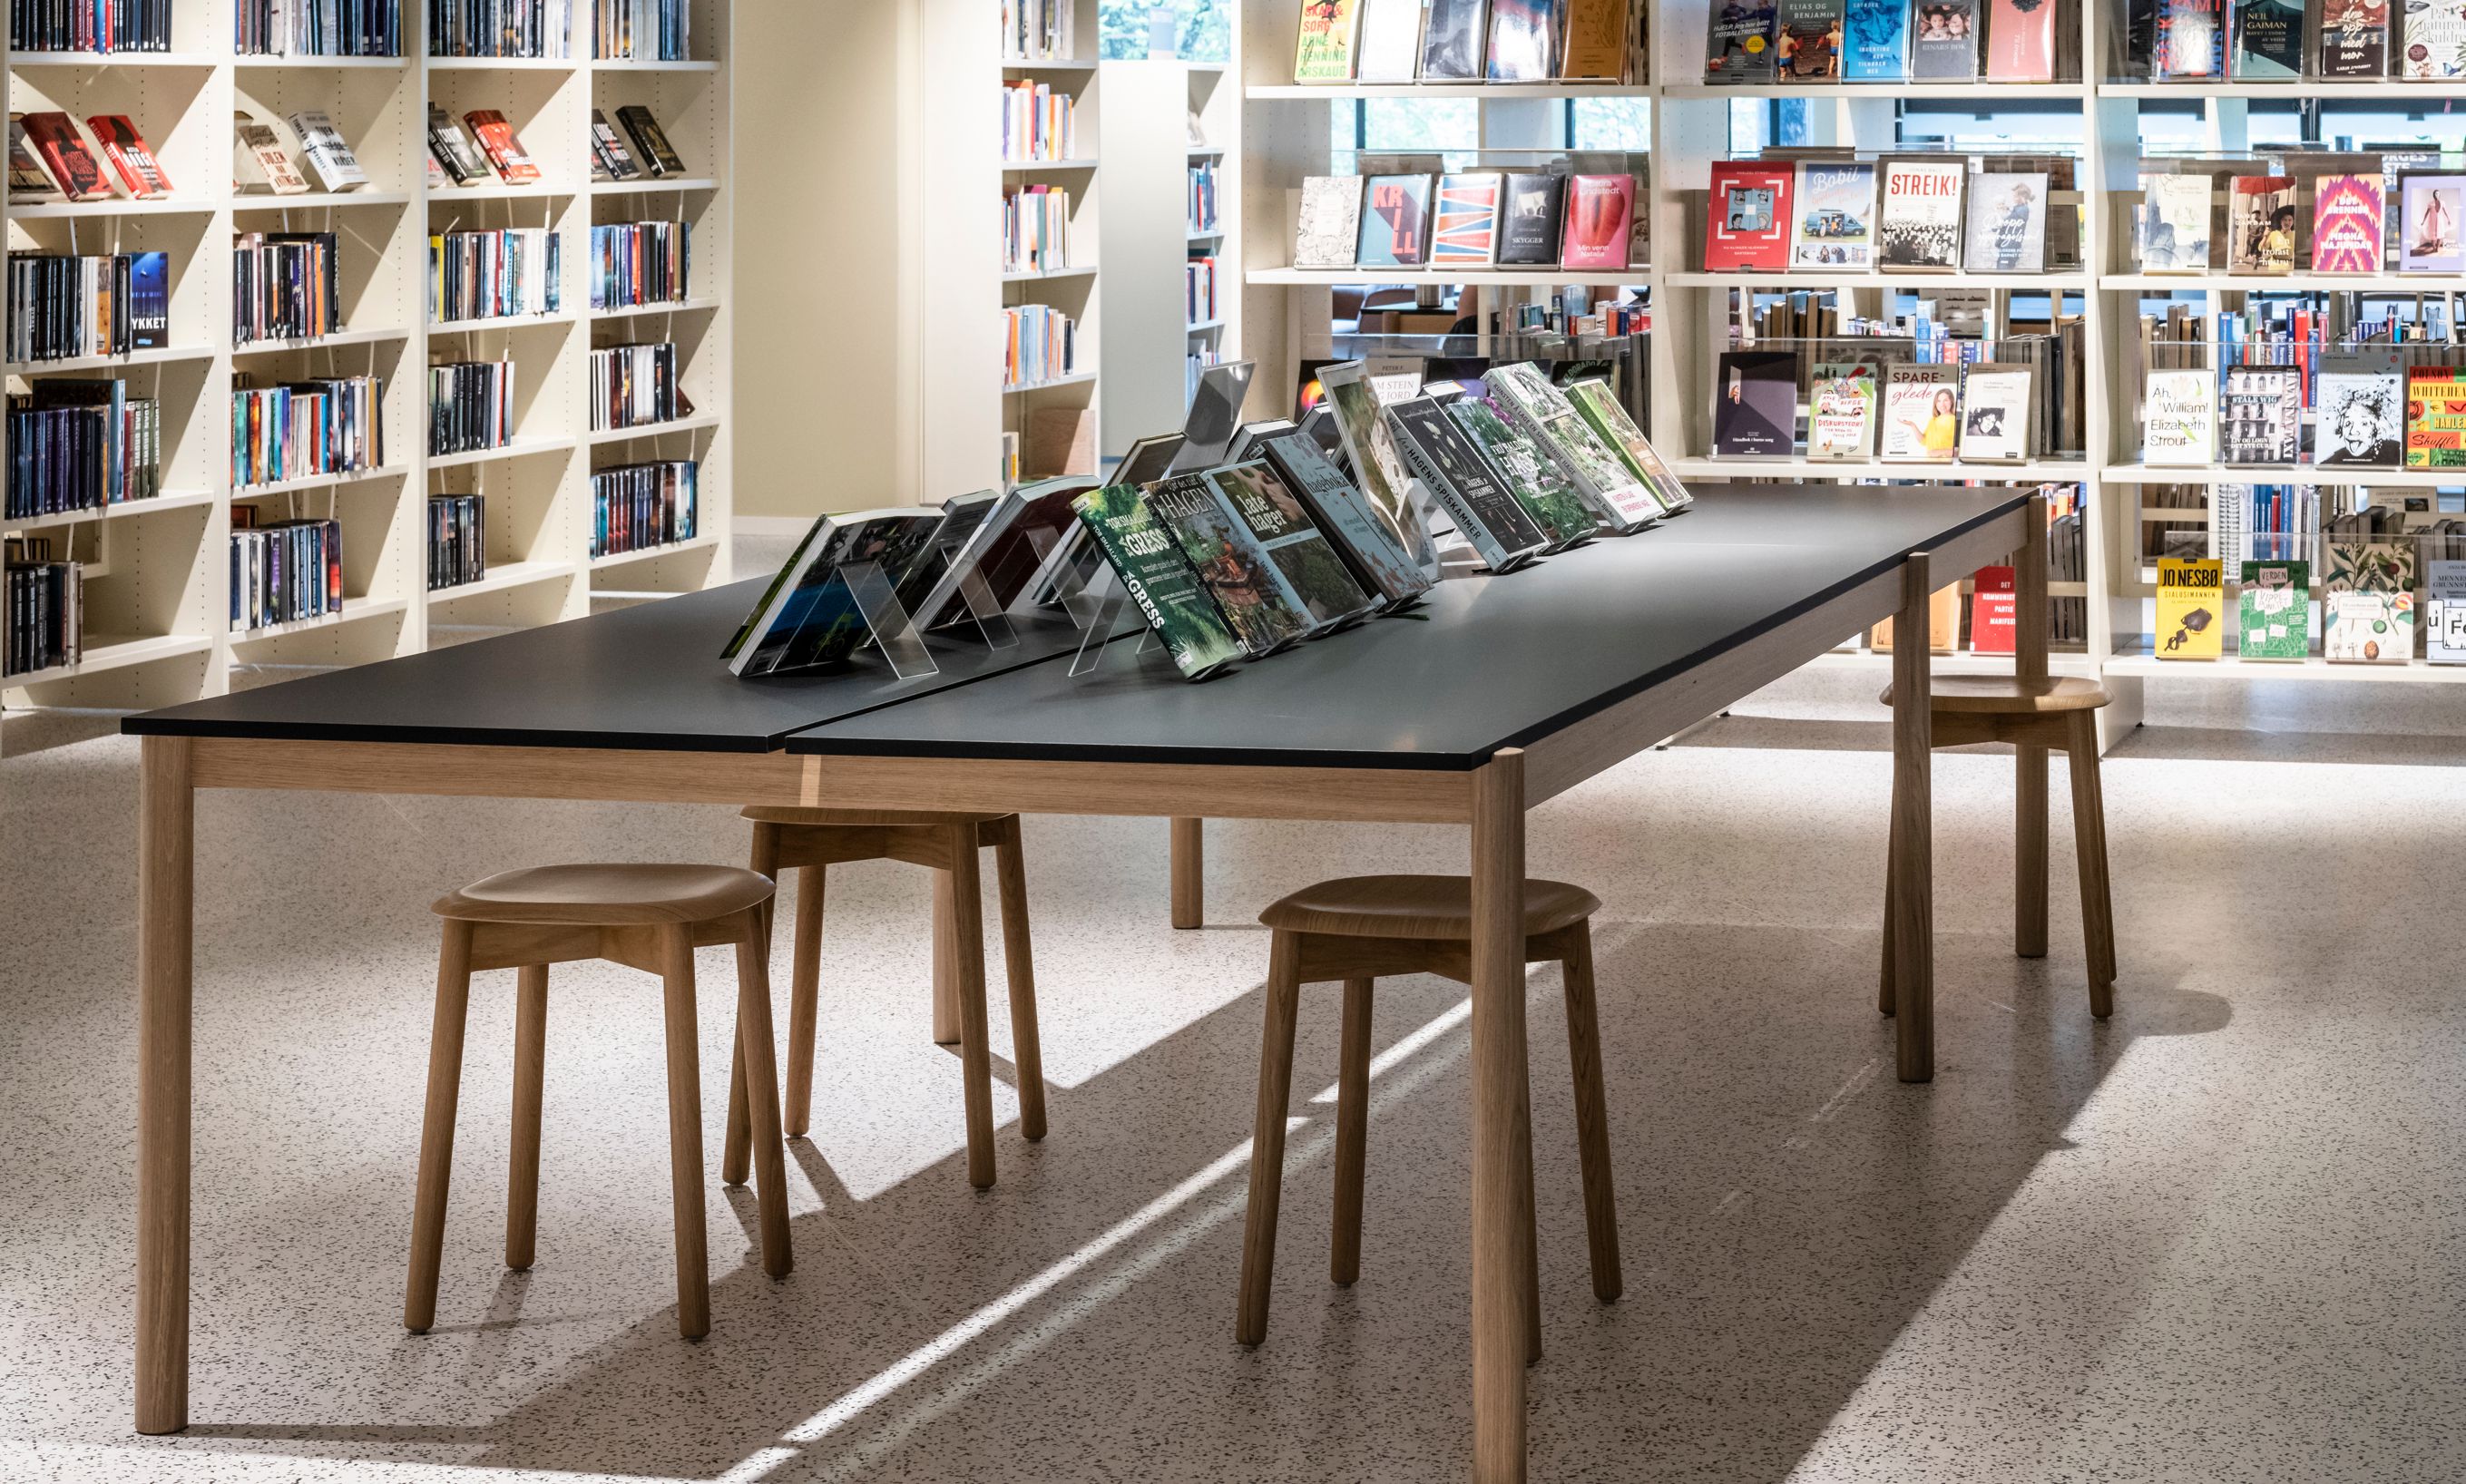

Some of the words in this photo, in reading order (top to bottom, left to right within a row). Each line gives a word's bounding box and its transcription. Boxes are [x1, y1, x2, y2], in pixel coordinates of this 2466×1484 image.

[2246, 21, 2287, 29] GAIMAN
[2342, 24, 2363, 36] opp
[2340, 34, 2365, 48] med
[2340, 52, 2365, 61] mor
[1813, 166, 1860, 194] Bobil
[1891, 173, 1957, 196] STREIK!
[1512, 236, 1543, 244] SKYGGER
[1893, 372, 1945, 384] SPARE-
[2412, 368, 2451, 379] COLSON
[1386, 380, 1414, 390] STEIN
[1386, 390, 1411, 400] JORD
[1891, 383, 1933, 406] glede
[2259, 395, 2277, 404] WIG
[2163, 402, 2208, 414] William!
[1492, 381, 1515, 408] KUNSTEN
[1516, 408, 1531, 425] LAGE
[1527, 422, 1539, 433] EN
[1534, 429, 1564, 463] SPENNENDE
[1560, 458, 1577, 476] HAGE
[2150, 419, 2206, 431] Elizabeth
[2149, 434, 2187, 447] Strout
[2283, 423, 2295, 459] TAXI
[1499, 448, 1541, 476] HAGE
[1301, 472, 1349, 495] hageboka
[1405, 447, 1437, 485] HAGENS
[1433, 482, 1483, 541] SPISKAMMER
[1591, 493, 1603, 505] Lars
[1160, 486, 1217, 519] HAGEN
[1236, 493, 1269, 516] late
[1244, 509, 1287, 533] hager
[1091, 523, 1103, 538] TOR
[1098, 534, 1123, 568] SMAALAND
[1125, 528, 1169, 556] GRESS
[1258, 559, 1271, 574] late
[1267, 571, 1284, 592] hager
[2162, 569, 2176, 587] JO
[2177, 569, 2218, 587] NESBØ
[2261, 569, 2287, 581] VERDEN
[2001, 581, 2011, 589] DET
[2165, 591, 2216, 599] SJALUSIMANNEN
[1124, 576, 1167, 630] GRESS
[1994, 605, 2013, 613] PARTIS
